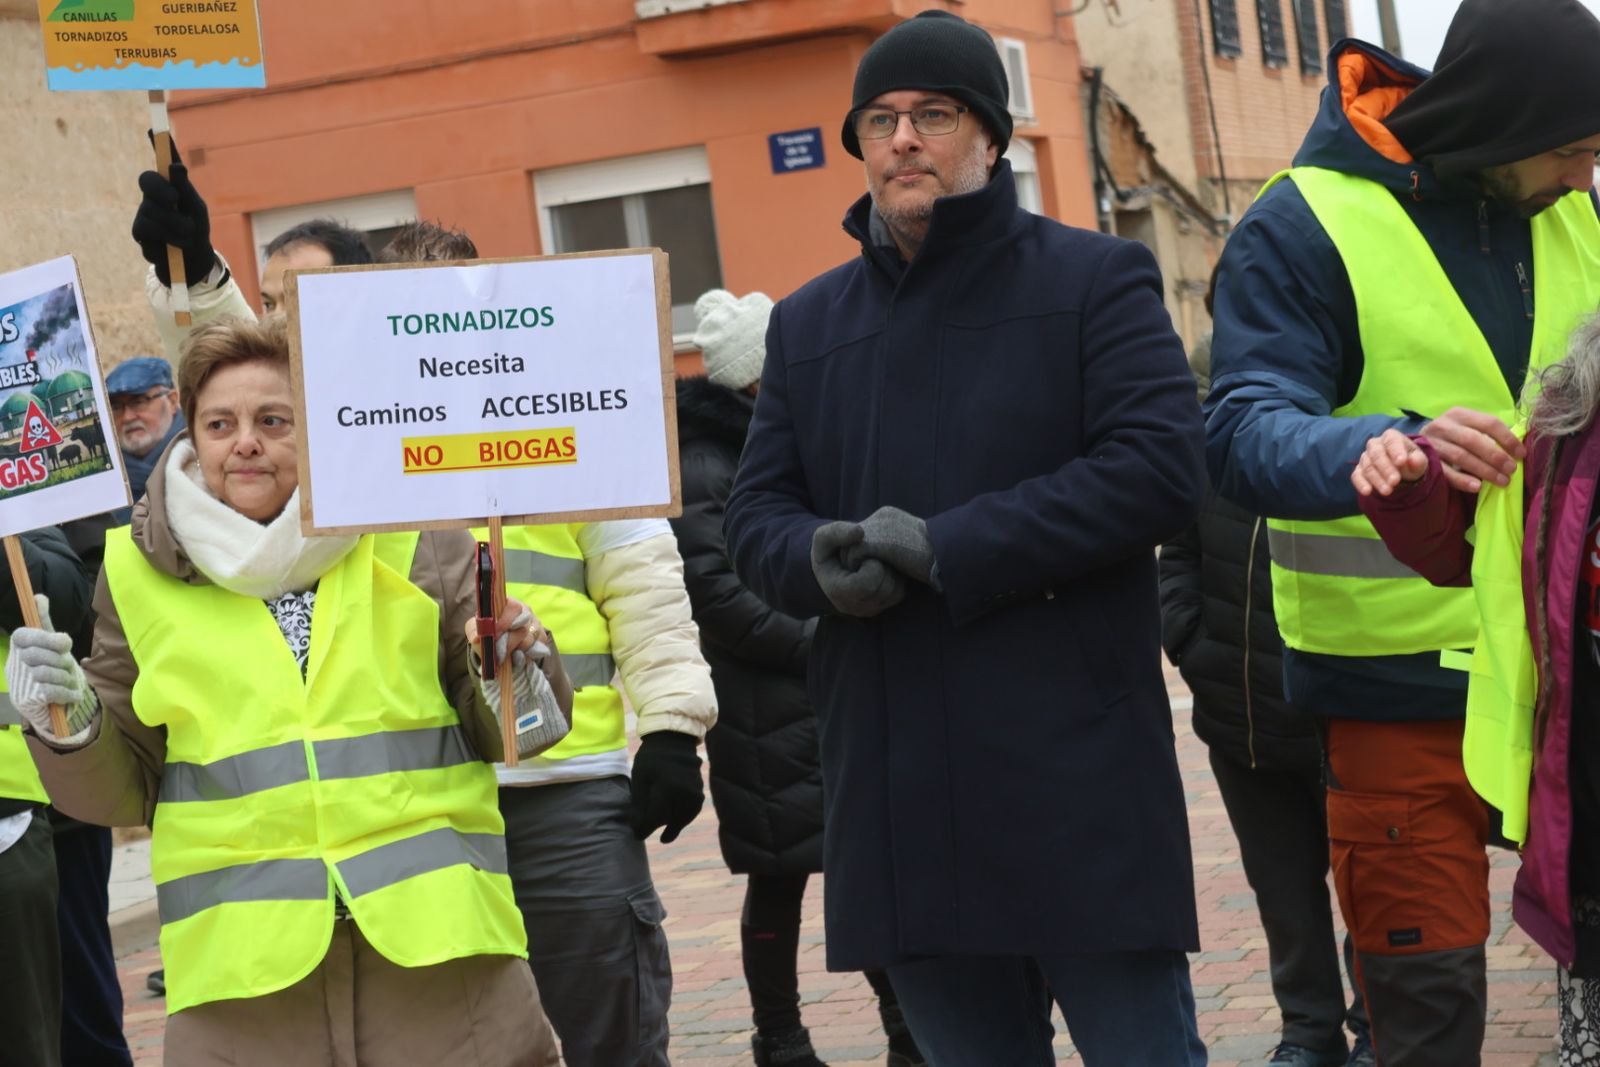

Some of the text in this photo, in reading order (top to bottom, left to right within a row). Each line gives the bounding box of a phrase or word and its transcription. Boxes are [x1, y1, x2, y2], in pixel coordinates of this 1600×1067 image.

[162, 1, 237, 14] GUERIBAÑEZ
[63, 12, 117, 23] CANILLAS
[155, 24, 240, 36] TORDELALOSA
[55, 32, 128, 42] TORNADIZOS
[114, 48, 177, 58] TERRUBIAS
[387, 306, 554, 336] TORNADIZOS
[419, 353, 525, 378] Necesita
[337, 389, 628, 427] Caminos ACCESIBLES
[403, 436, 576, 467] NO BIOGAS
